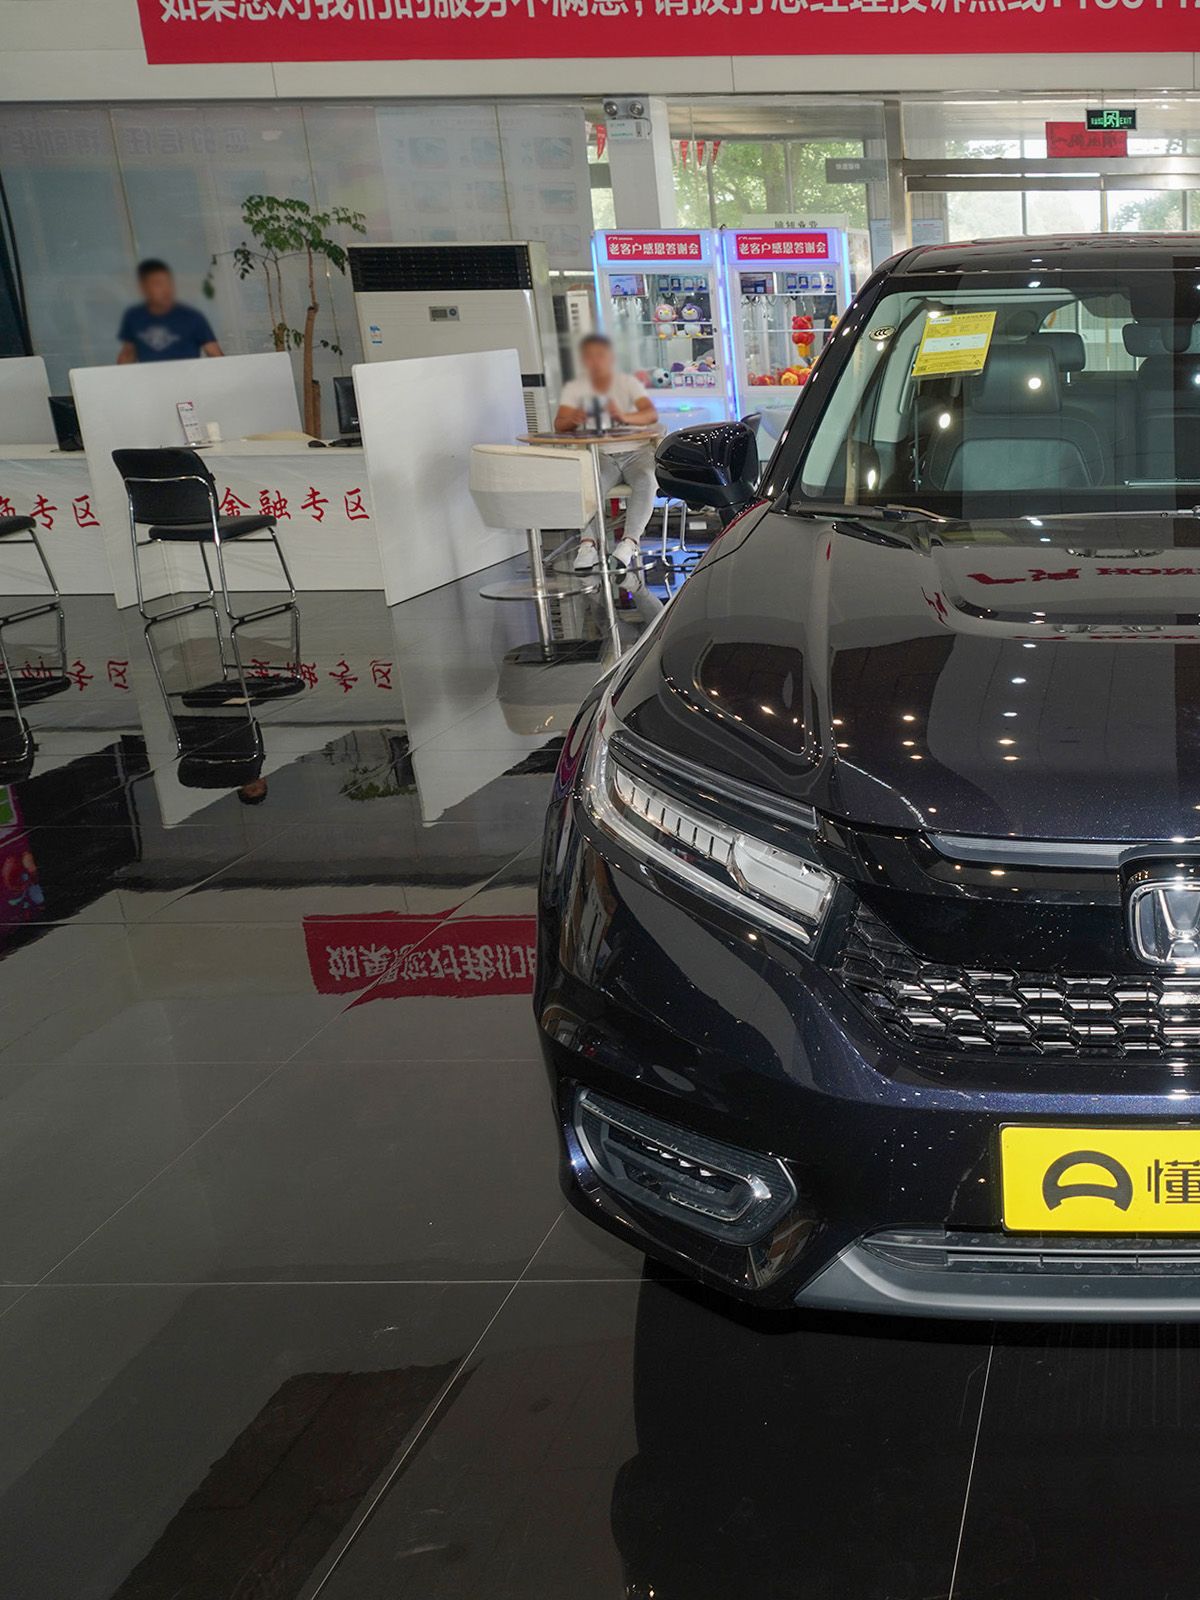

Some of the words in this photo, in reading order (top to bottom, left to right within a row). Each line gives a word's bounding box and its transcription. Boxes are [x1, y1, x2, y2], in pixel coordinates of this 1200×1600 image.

[609, 242, 699, 255] 老客户感恩答谢会
[739, 241, 826, 254] 老客户感恩答谢会
[219, 487, 370, 523] 金融专区
